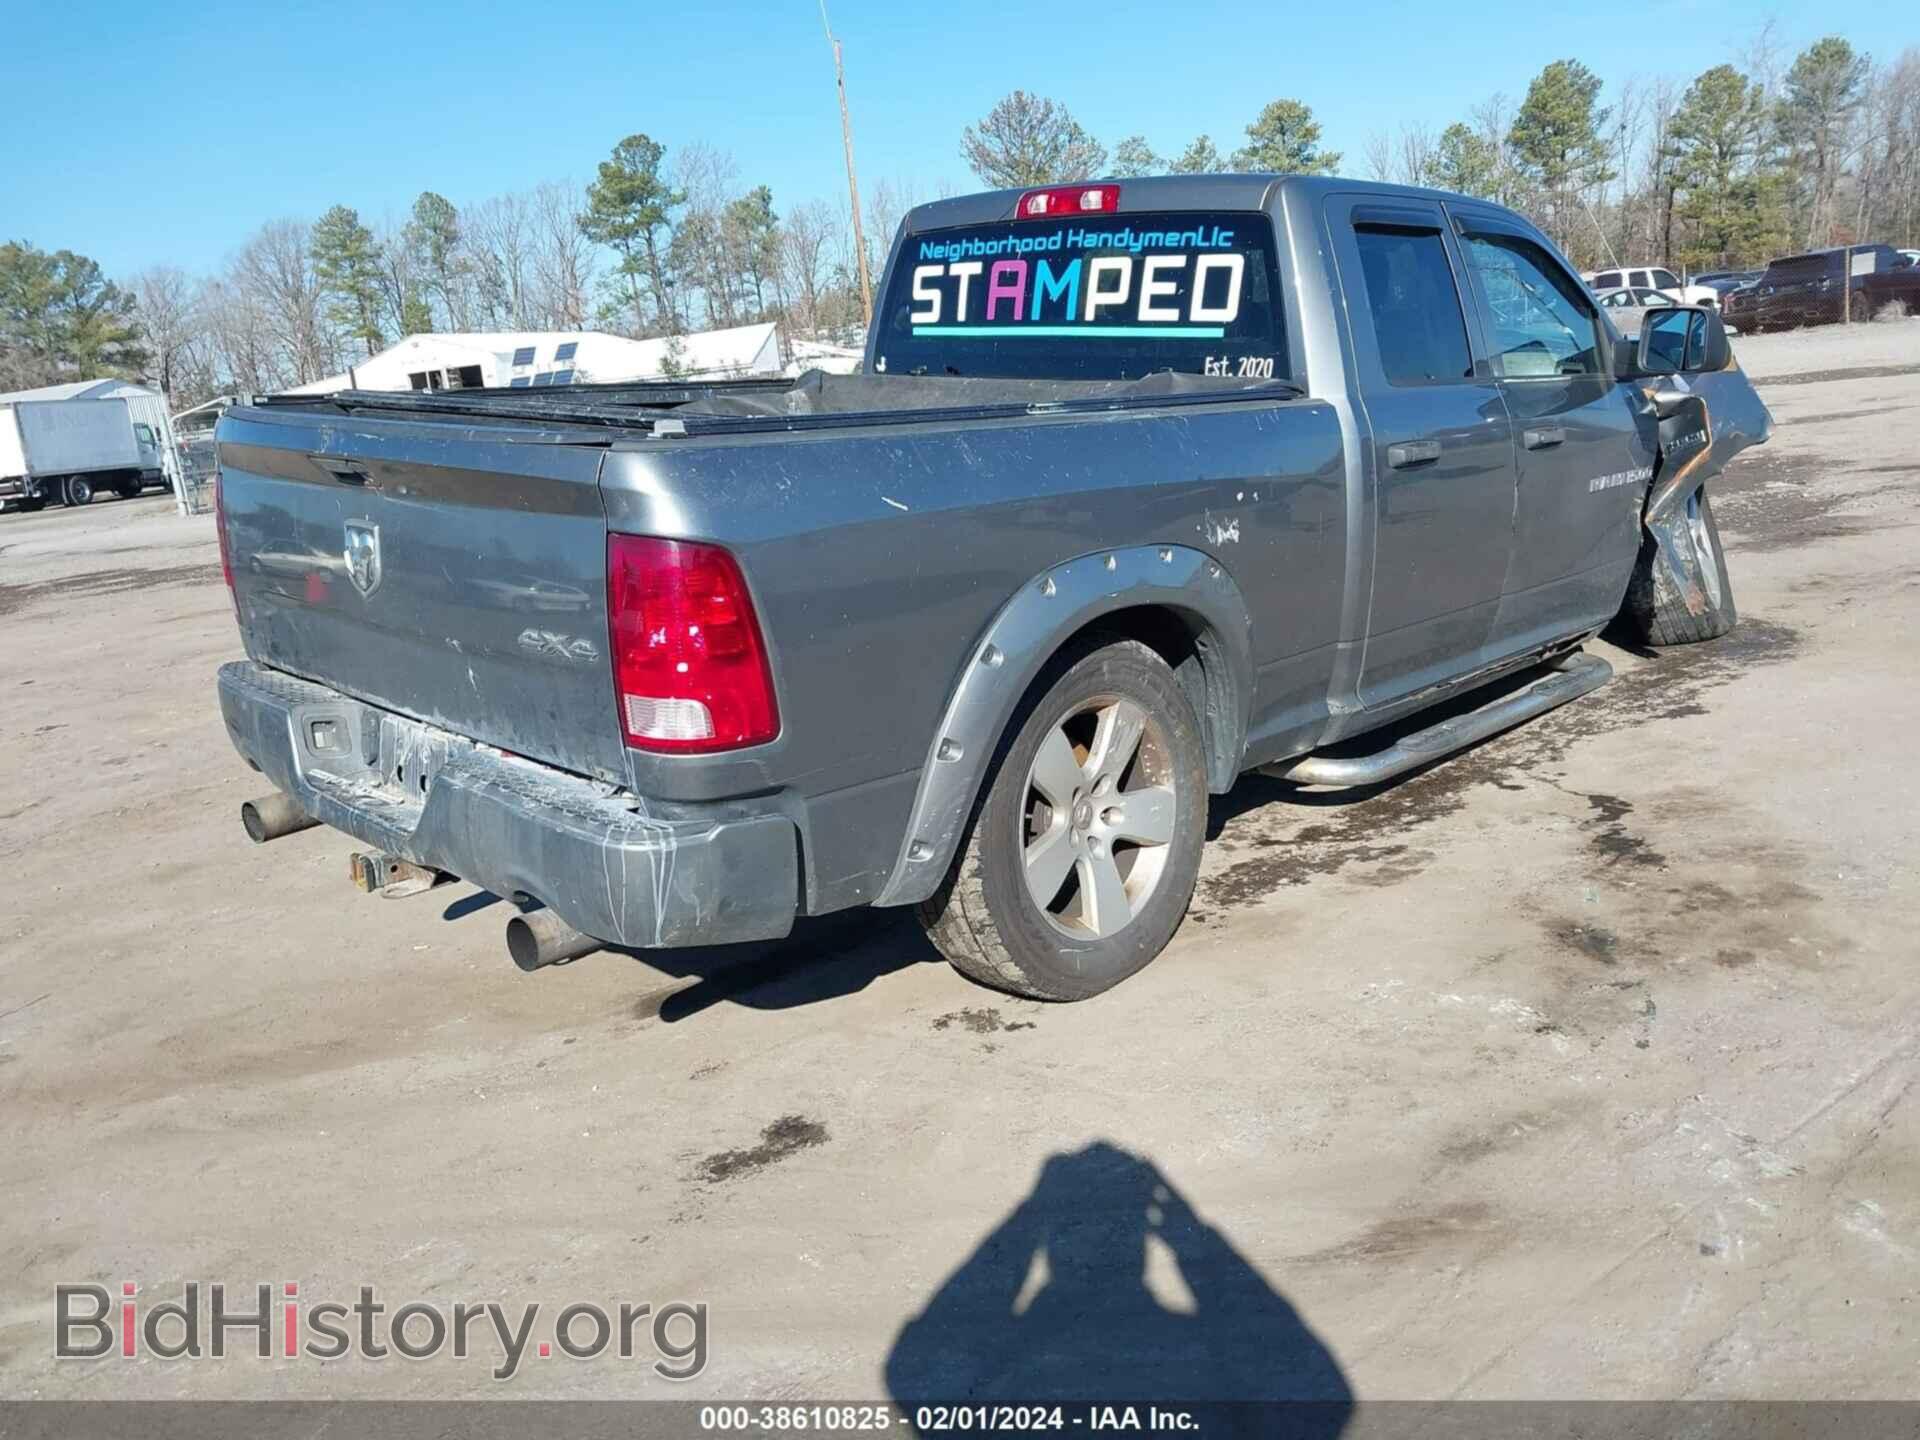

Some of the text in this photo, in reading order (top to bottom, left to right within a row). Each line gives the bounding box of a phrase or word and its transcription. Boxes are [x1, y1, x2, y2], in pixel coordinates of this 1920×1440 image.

[919, 229, 1063, 262] Neighborhood
[910, 253, 1245, 324] STAMPED
[1204, 355, 1275, 379] Est. 2020
